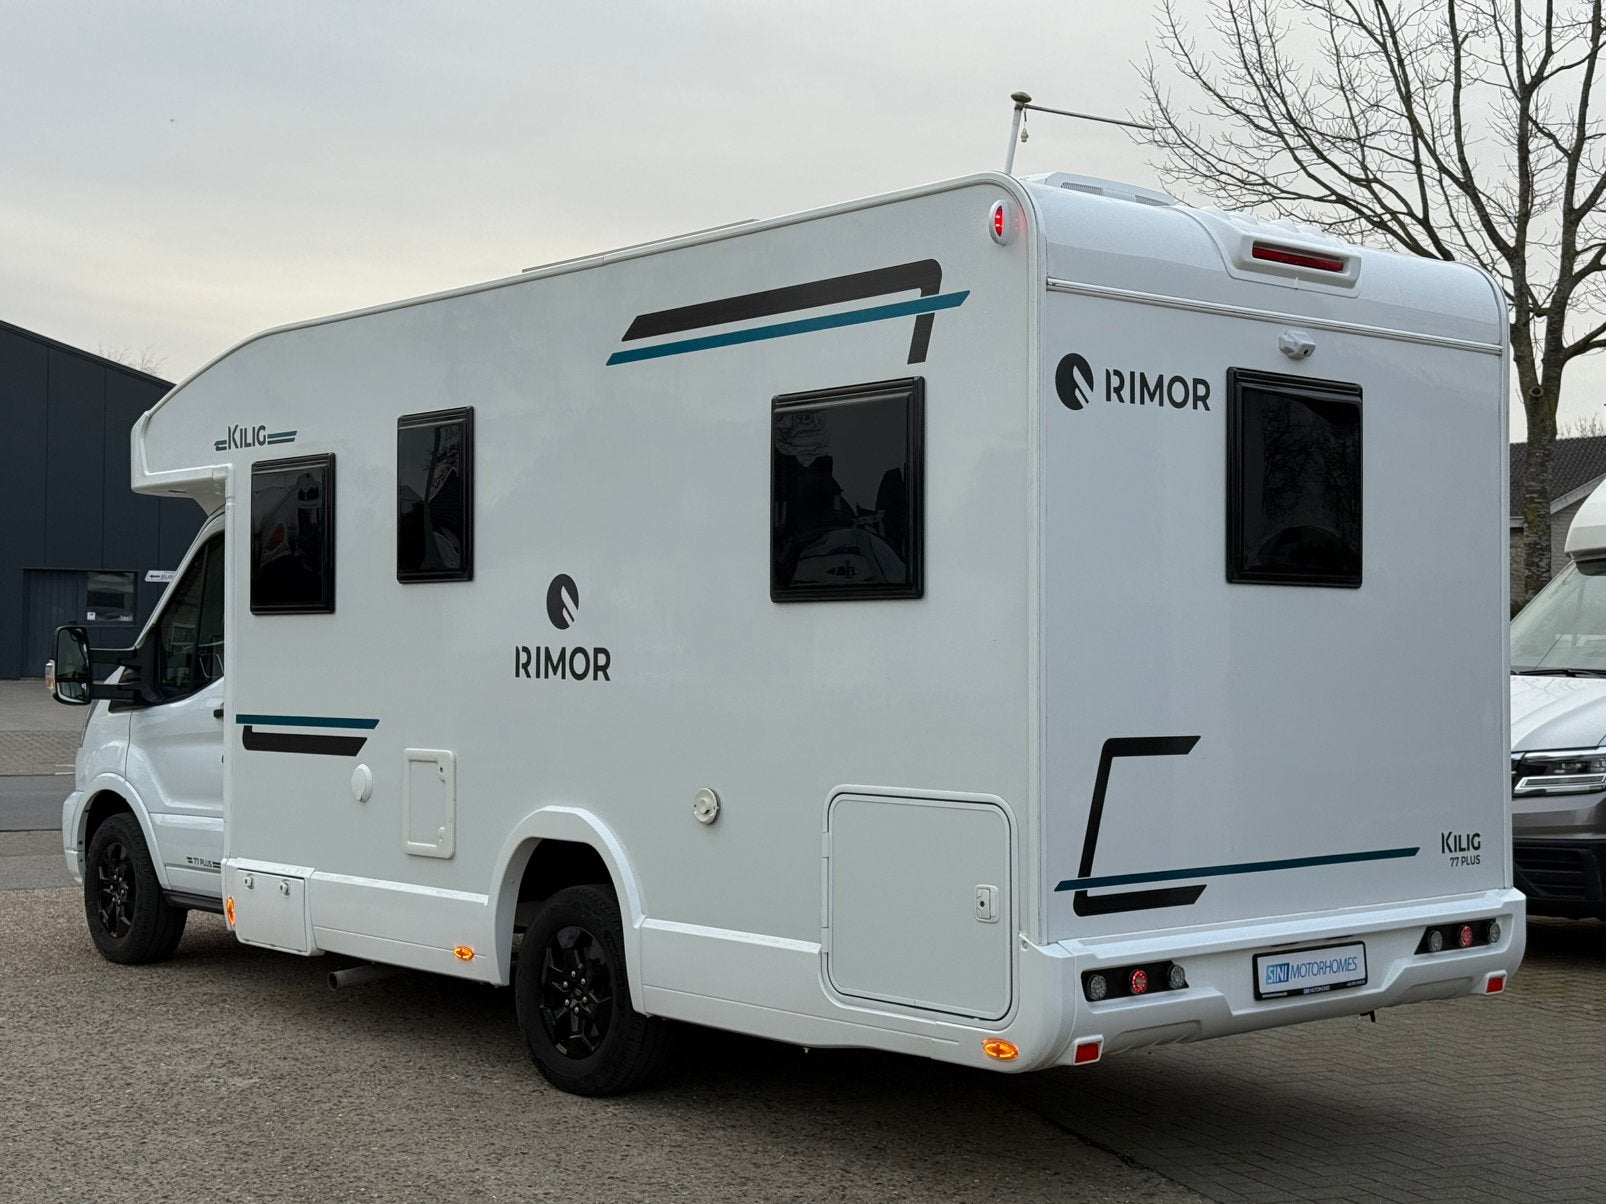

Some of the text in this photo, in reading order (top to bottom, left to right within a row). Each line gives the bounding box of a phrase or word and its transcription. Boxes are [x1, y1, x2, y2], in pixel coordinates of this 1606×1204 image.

[1105, 368, 1211, 411] RIMOR
[228, 424, 267, 450] KILIG
[515, 645, 611, 681] RIMOR
[1441, 831, 1481, 854] KILIG
[1450, 854, 1481, 867] 77 PLUS
